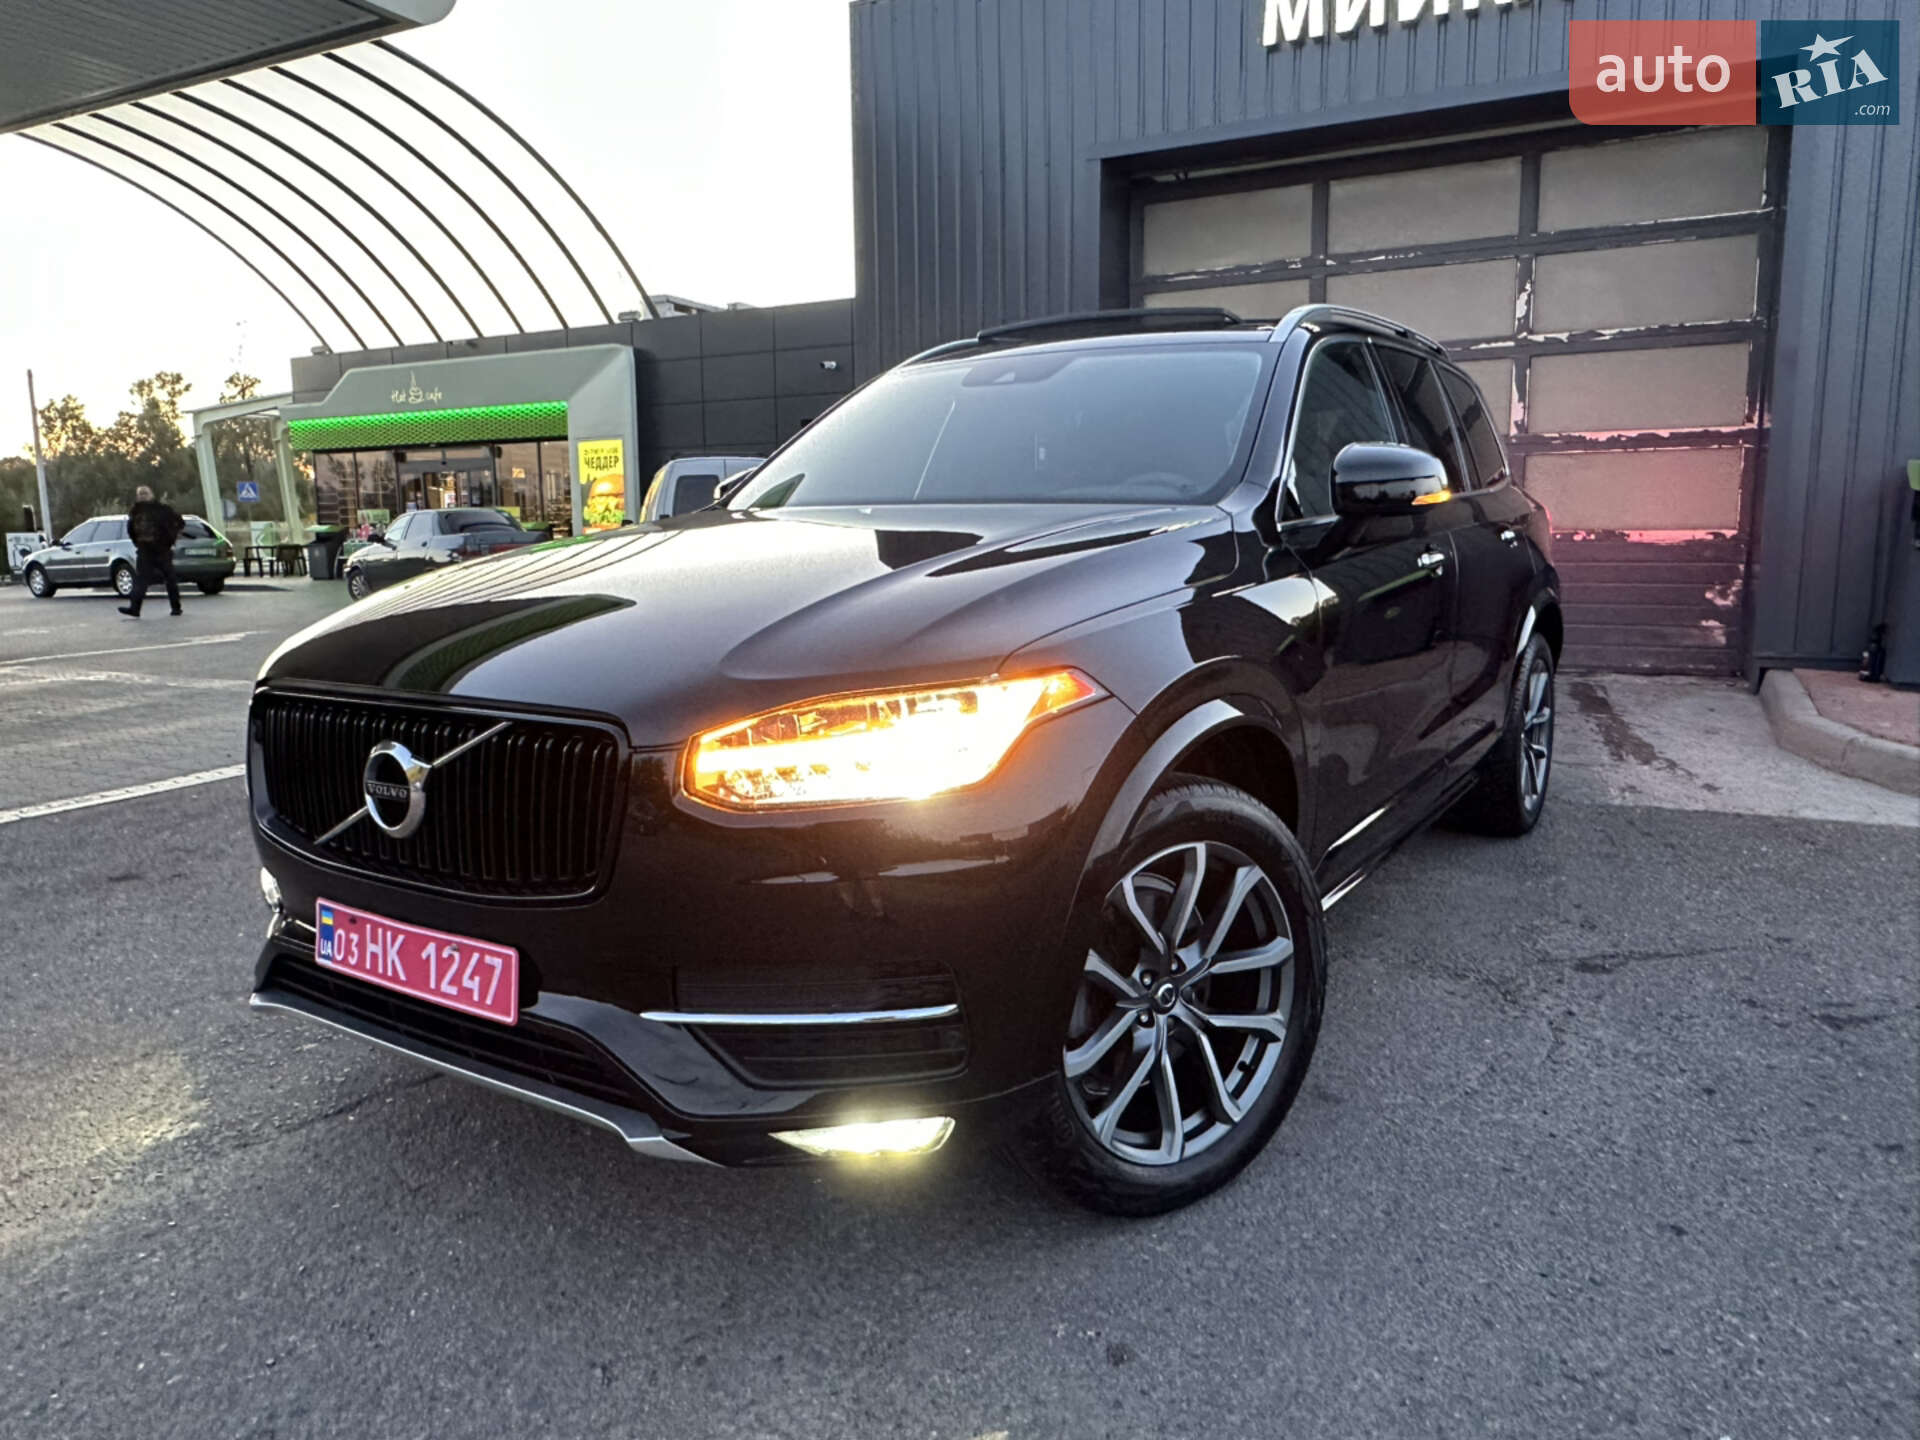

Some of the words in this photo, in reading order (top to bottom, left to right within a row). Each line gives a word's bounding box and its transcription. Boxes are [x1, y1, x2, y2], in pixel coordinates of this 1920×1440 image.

[584, 455, 620, 471] ЧЕДДЕР
[367, 783, 408, 799] VOLVO
[319, 937, 333, 957] UA
[333, 928, 360, 966] 03
[421, 941, 503, 1006] 1247
